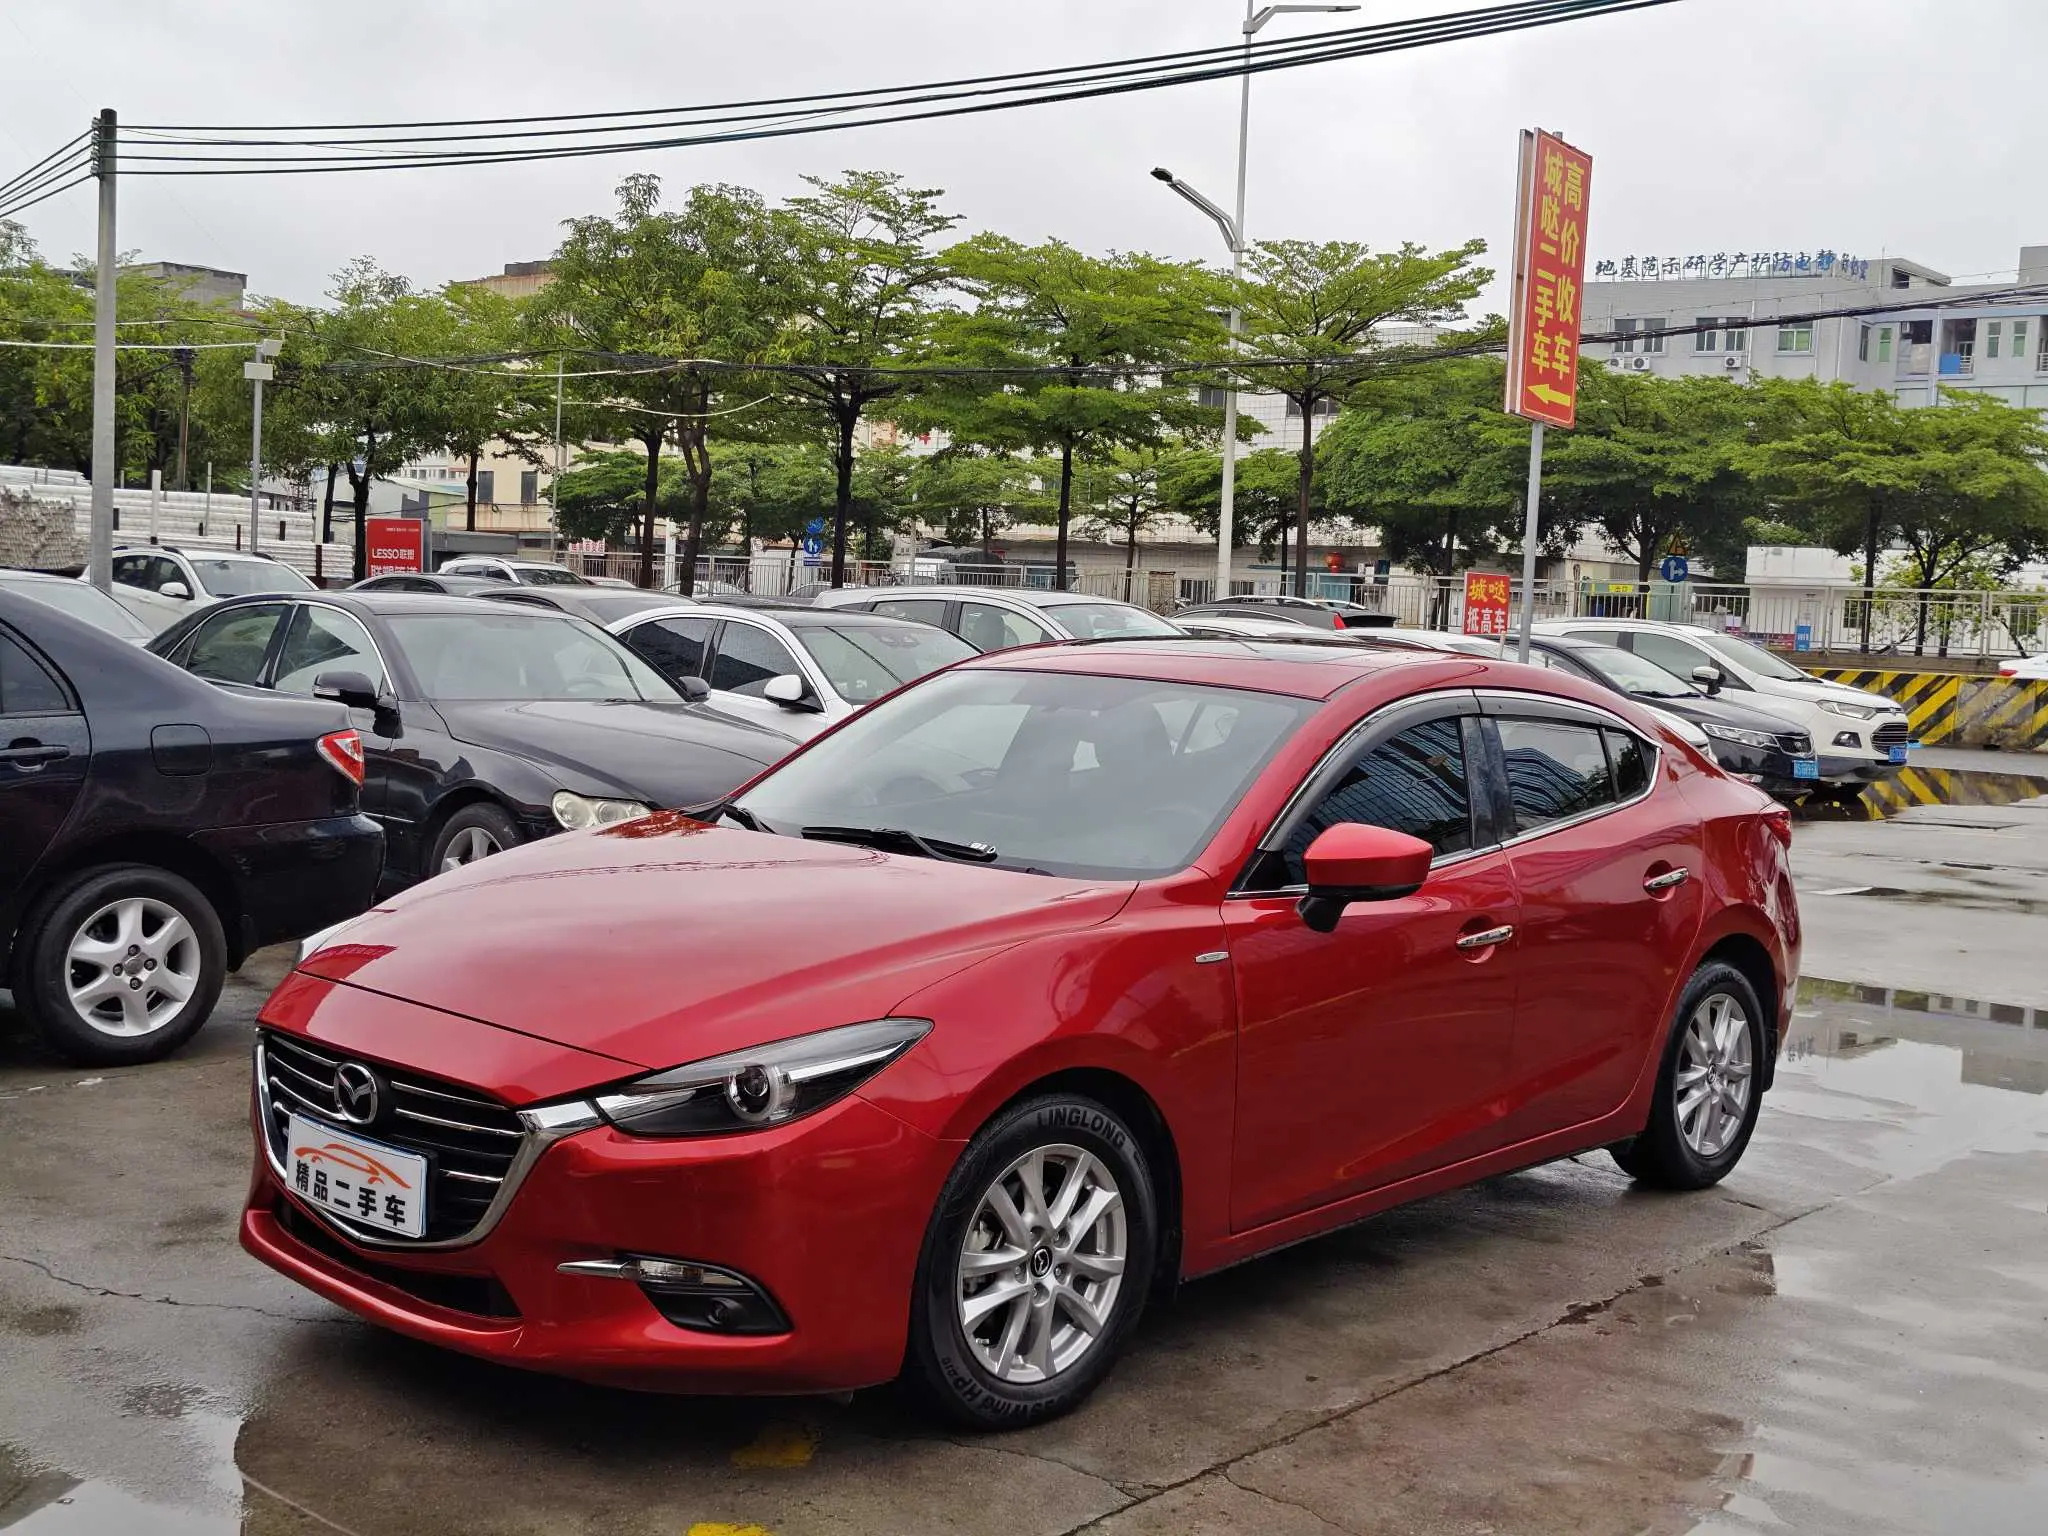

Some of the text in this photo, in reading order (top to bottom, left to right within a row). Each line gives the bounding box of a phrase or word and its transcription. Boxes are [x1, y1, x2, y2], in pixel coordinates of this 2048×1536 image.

[1551, 160, 1585, 380] 高价收车
[1468, 578, 1508, 604] 城哒
[1036, 1106, 1127, 1148] LINGLONG
[295, 1159, 407, 1227] 精品二手车
